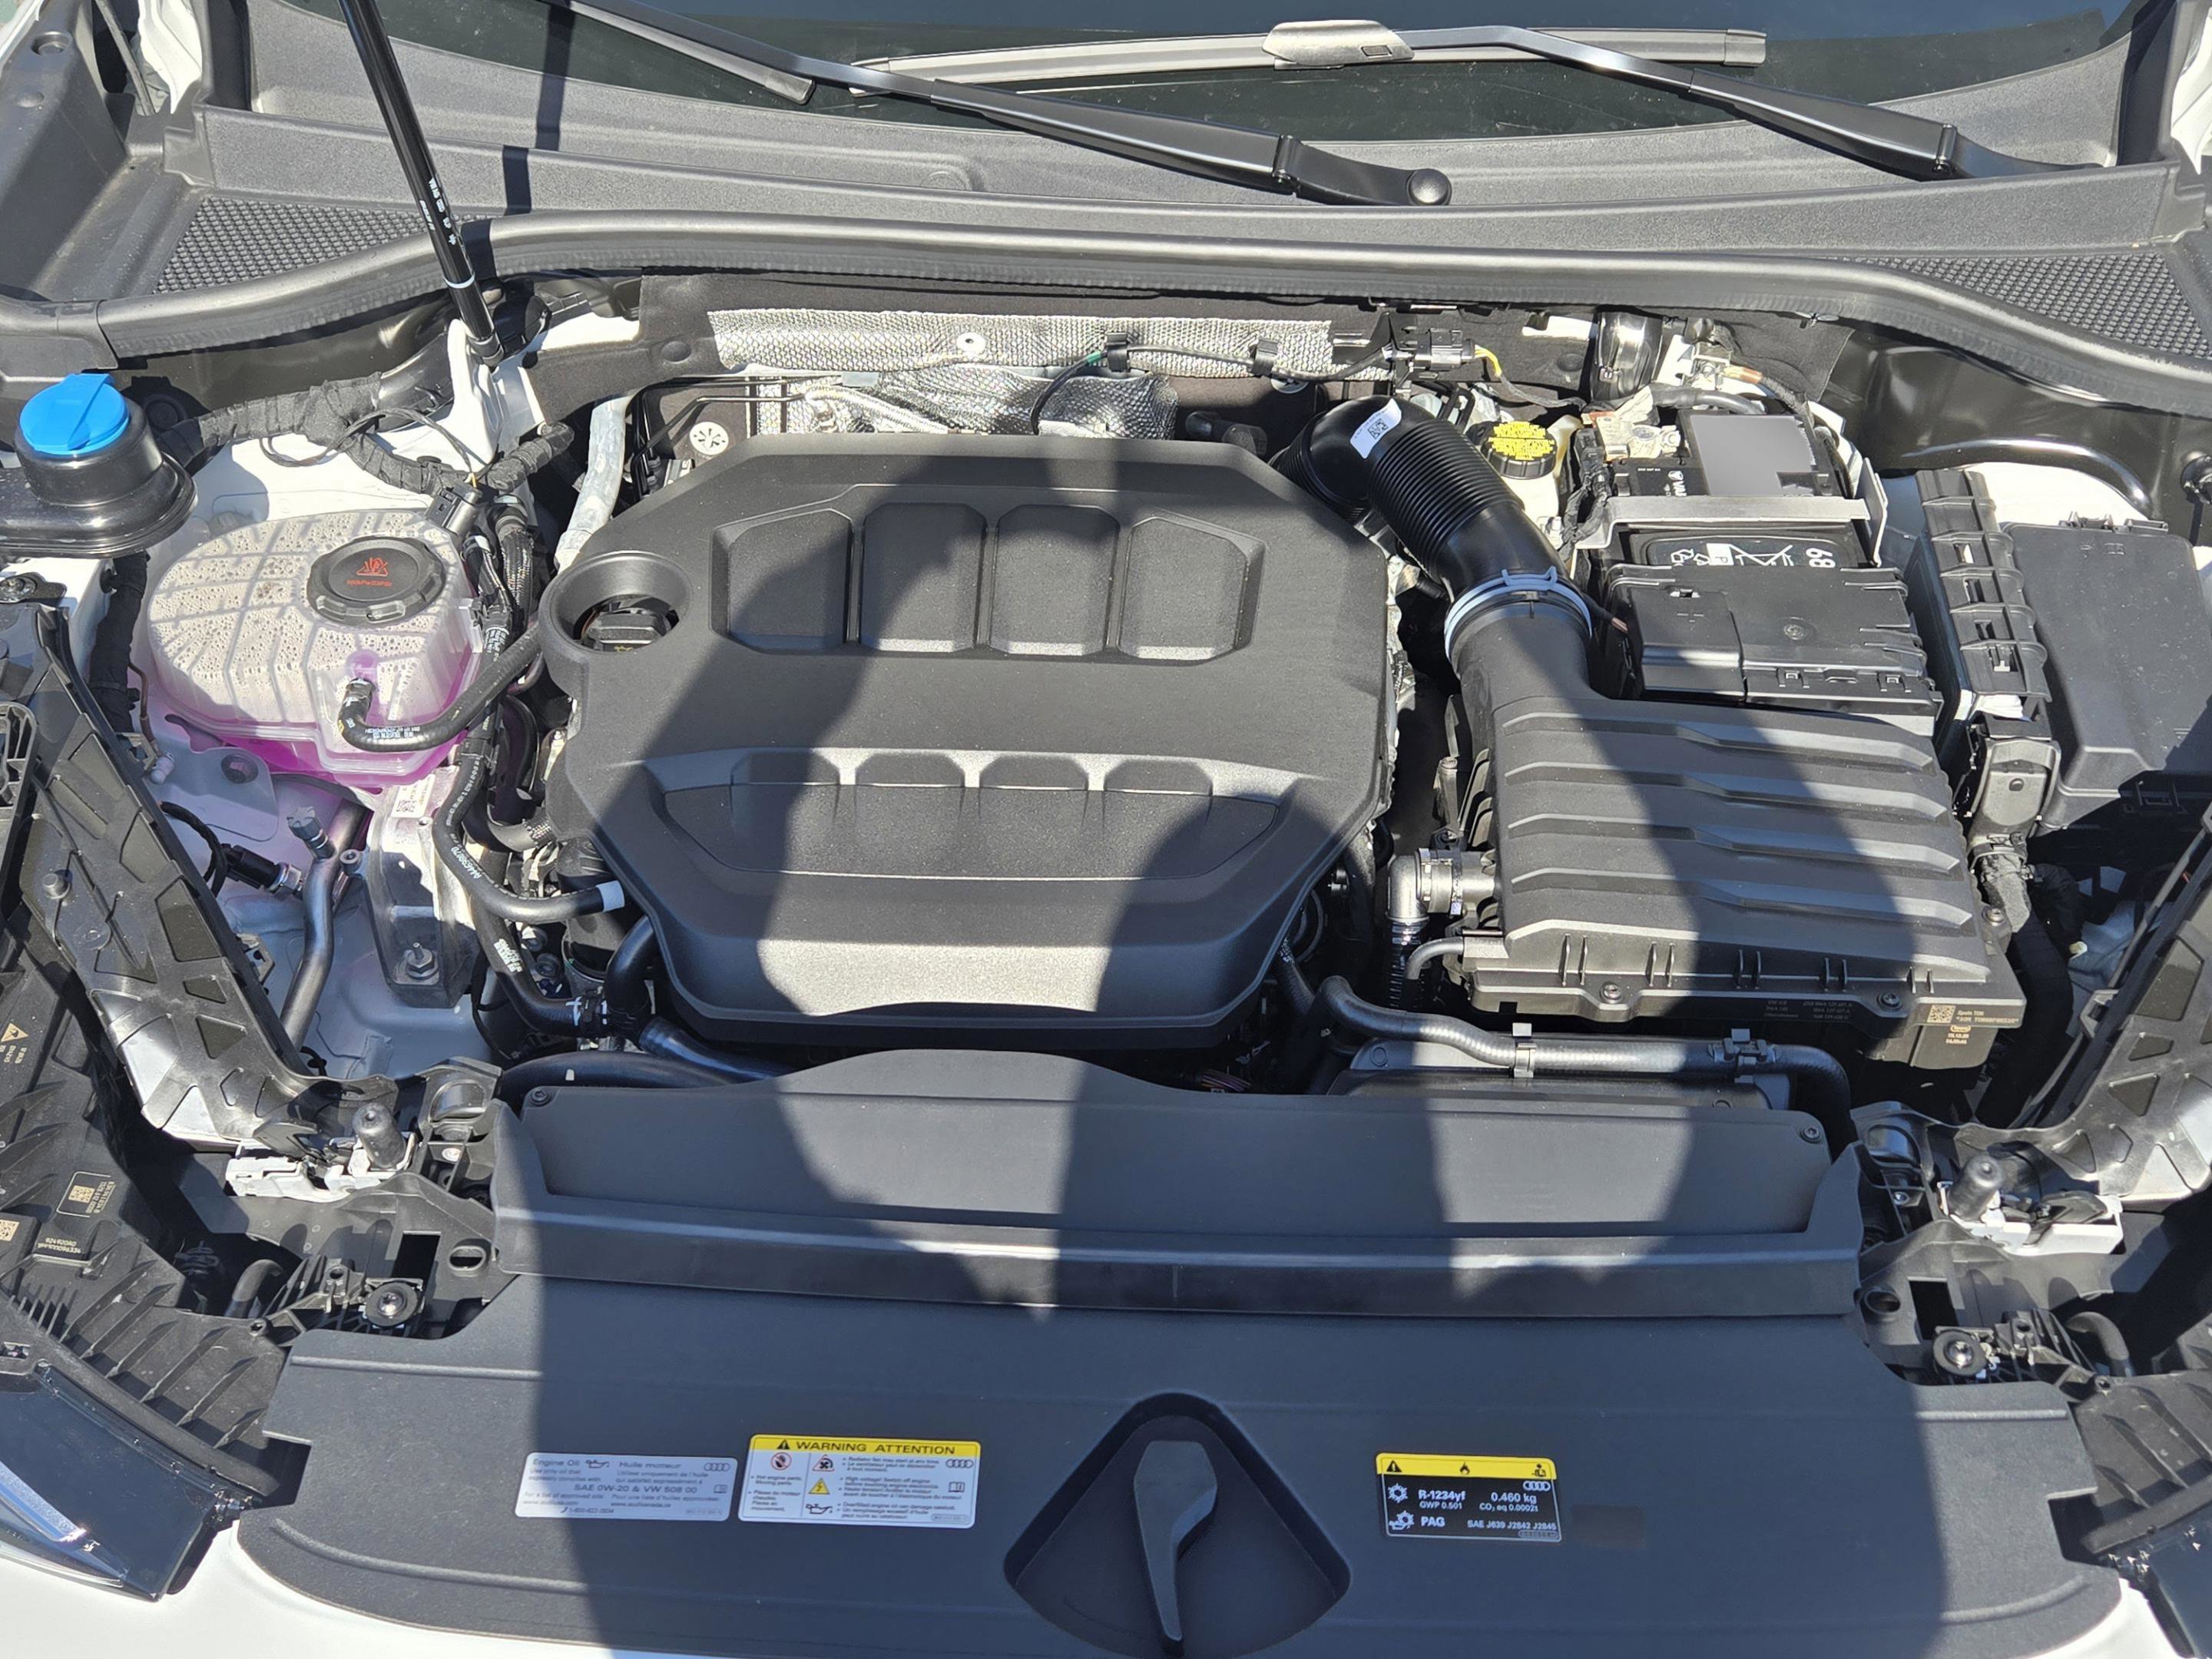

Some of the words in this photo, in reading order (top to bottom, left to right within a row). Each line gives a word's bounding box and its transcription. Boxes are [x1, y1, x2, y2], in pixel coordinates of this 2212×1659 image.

[796, 1441, 866, 1452] WARNING
[875, 1444, 955, 1454] ATTENTION
[1418, 1489, 1466, 1502] R-1234yf
[1491, 1492, 1521, 1502] 0.460
[1523, 1492, 1537, 1504] kg
[1497, 1504, 1507, 1512] eq
[1421, 1516, 1445, 1528] PAG
[1467, 1520, 1485, 1528] SAE
